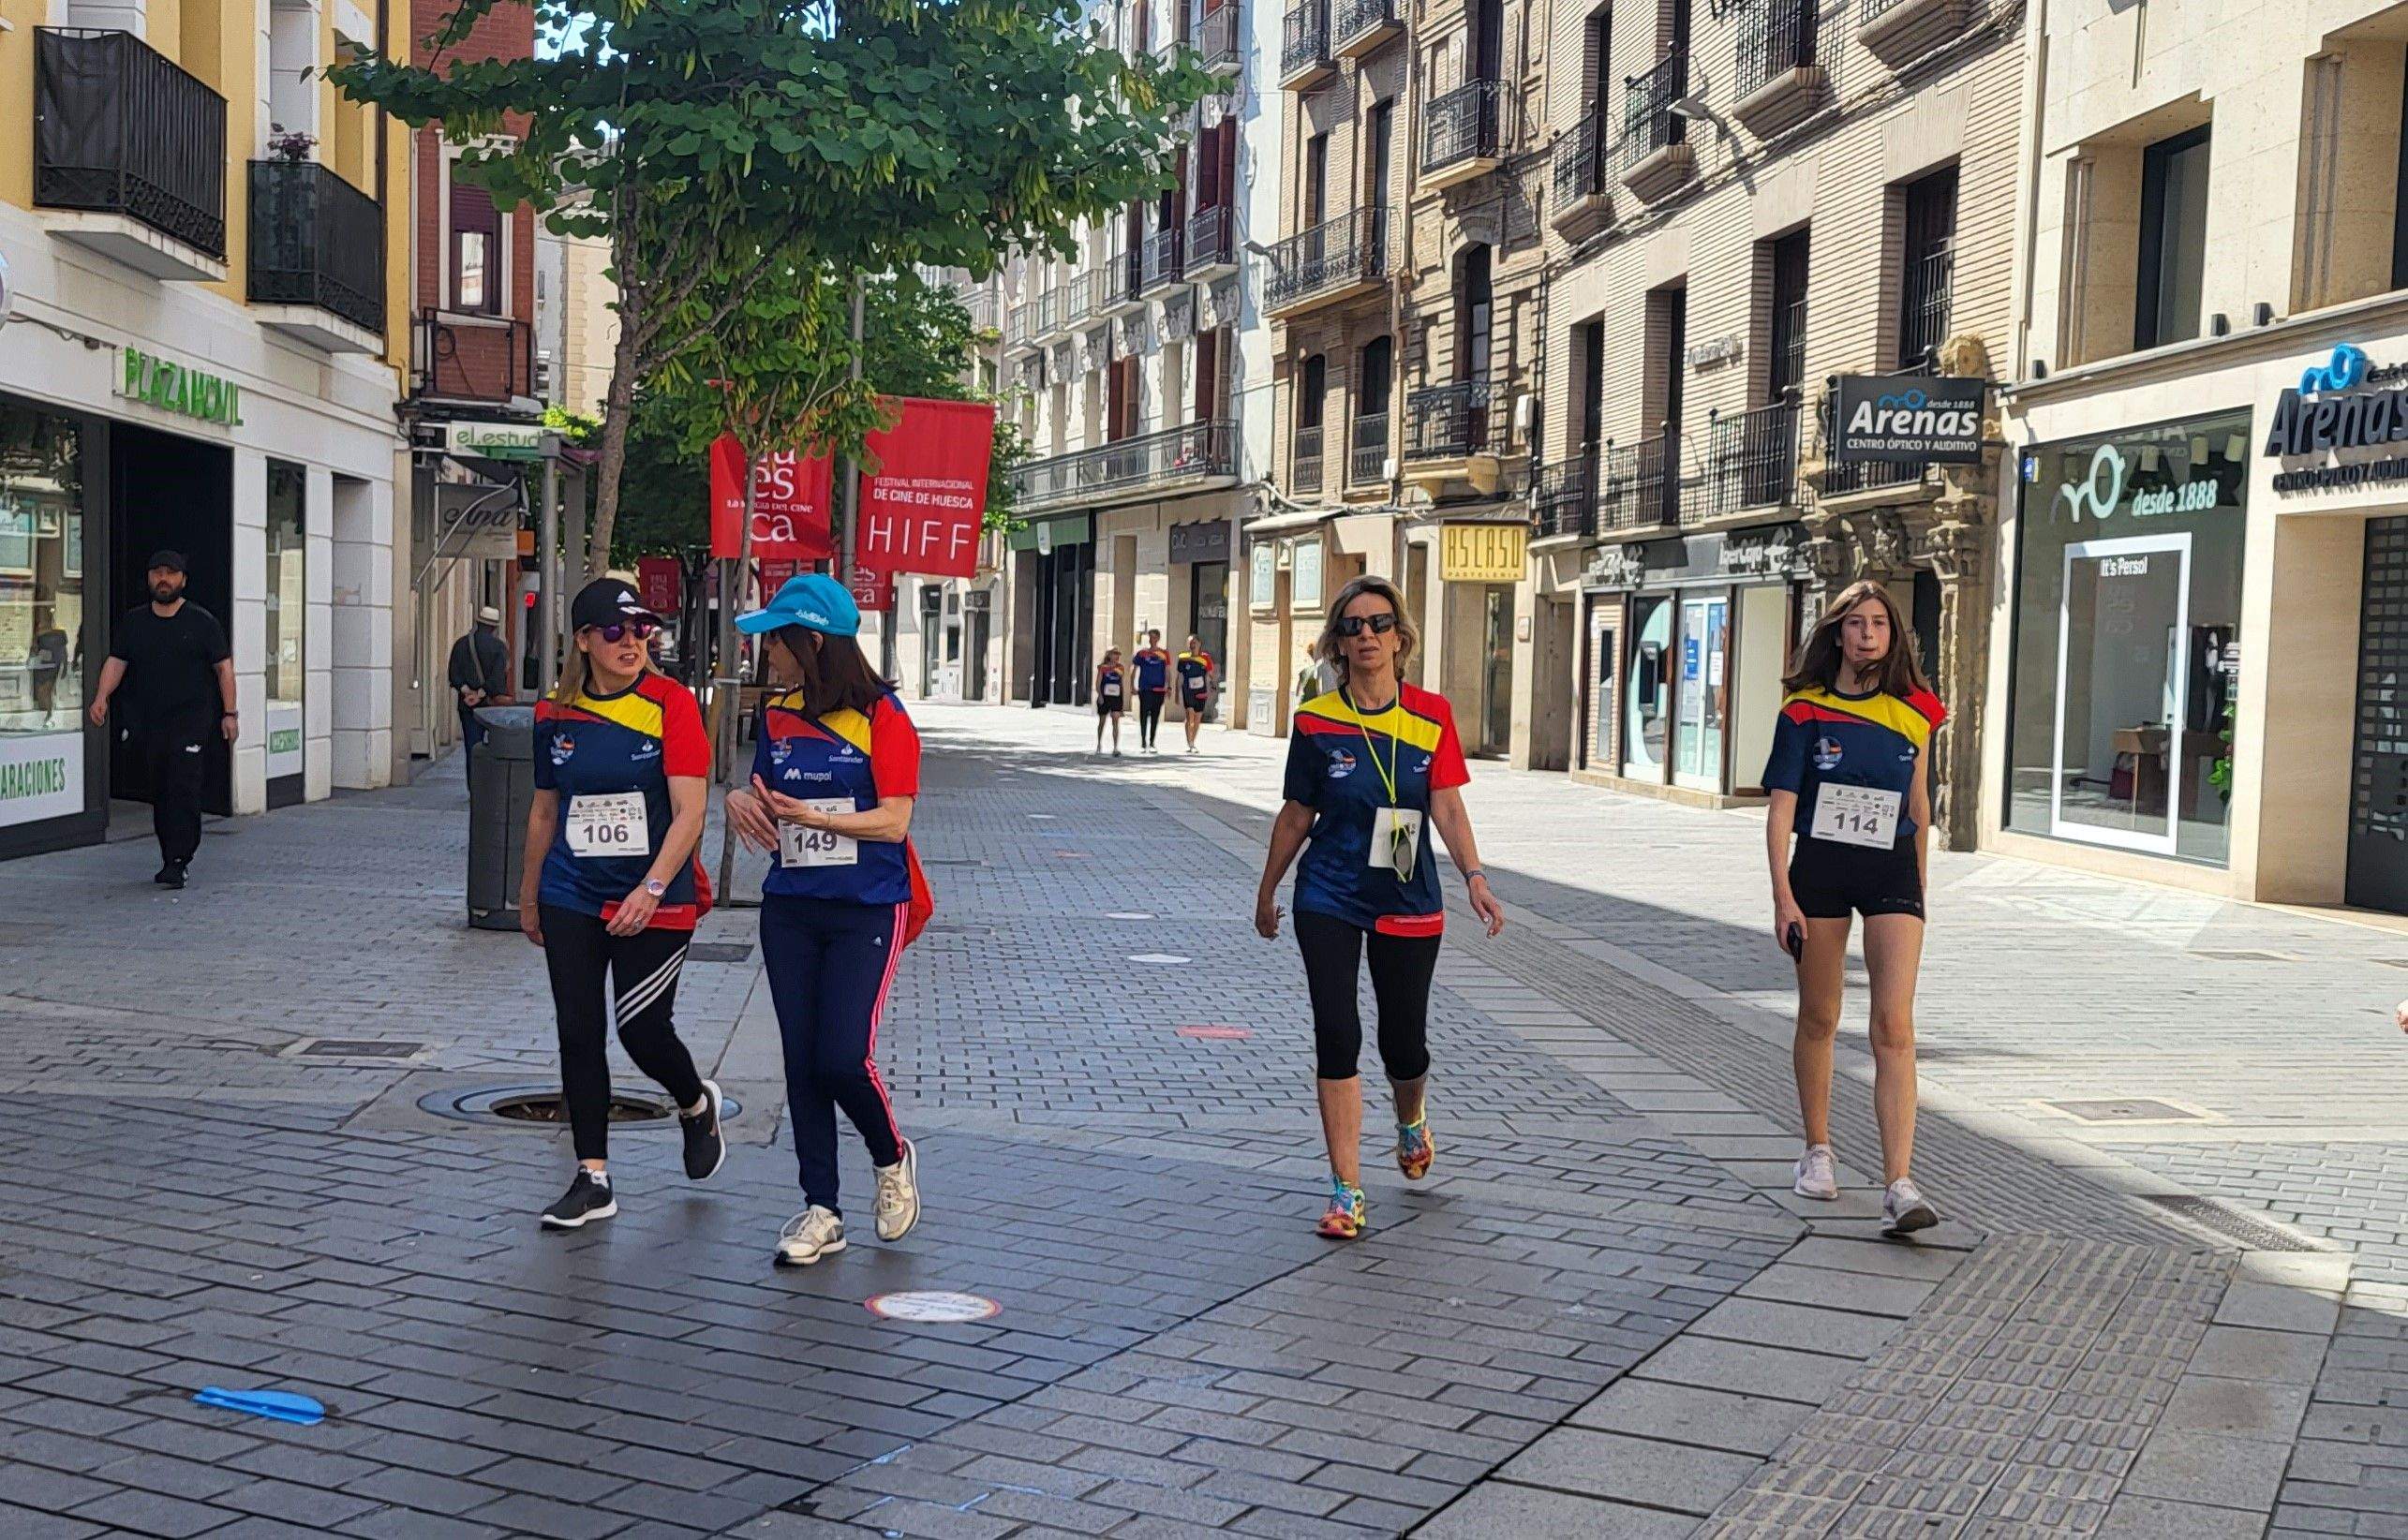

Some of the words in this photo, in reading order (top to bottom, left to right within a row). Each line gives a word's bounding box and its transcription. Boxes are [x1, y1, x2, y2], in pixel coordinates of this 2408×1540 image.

[1847, 400, 1979, 437] Arenas
[2264, 388, 2408, 457] Arenas
[1847, 438, 1884, 450] CENTRO
[1925, 440, 1931, 451] Y
[1932, 440, 1977, 452] AUDITIVO
[874, 477, 910, 487] FESTIVAL
[912, 478, 974, 490] INTERNACIONAL
[873, 488, 888, 499] DE
[890, 489, 914, 503] CINE
[915, 492, 929, 505] DE
[931, 495, 974, 509] HUESCA
[2132, 484, 2175, 516] desde
[2176, 479, 2218, 512] 1888
[751, 512, 797, 542] ca
[868, 514, 972, 559] HIFF
[828, 755, 864, 764] Santander
[803, 770, 832, 782] mupol
[583, 824, 629, 843] 106
[1834, 812, 1879, 835] 114
[794, 832, 838, 853] 149
